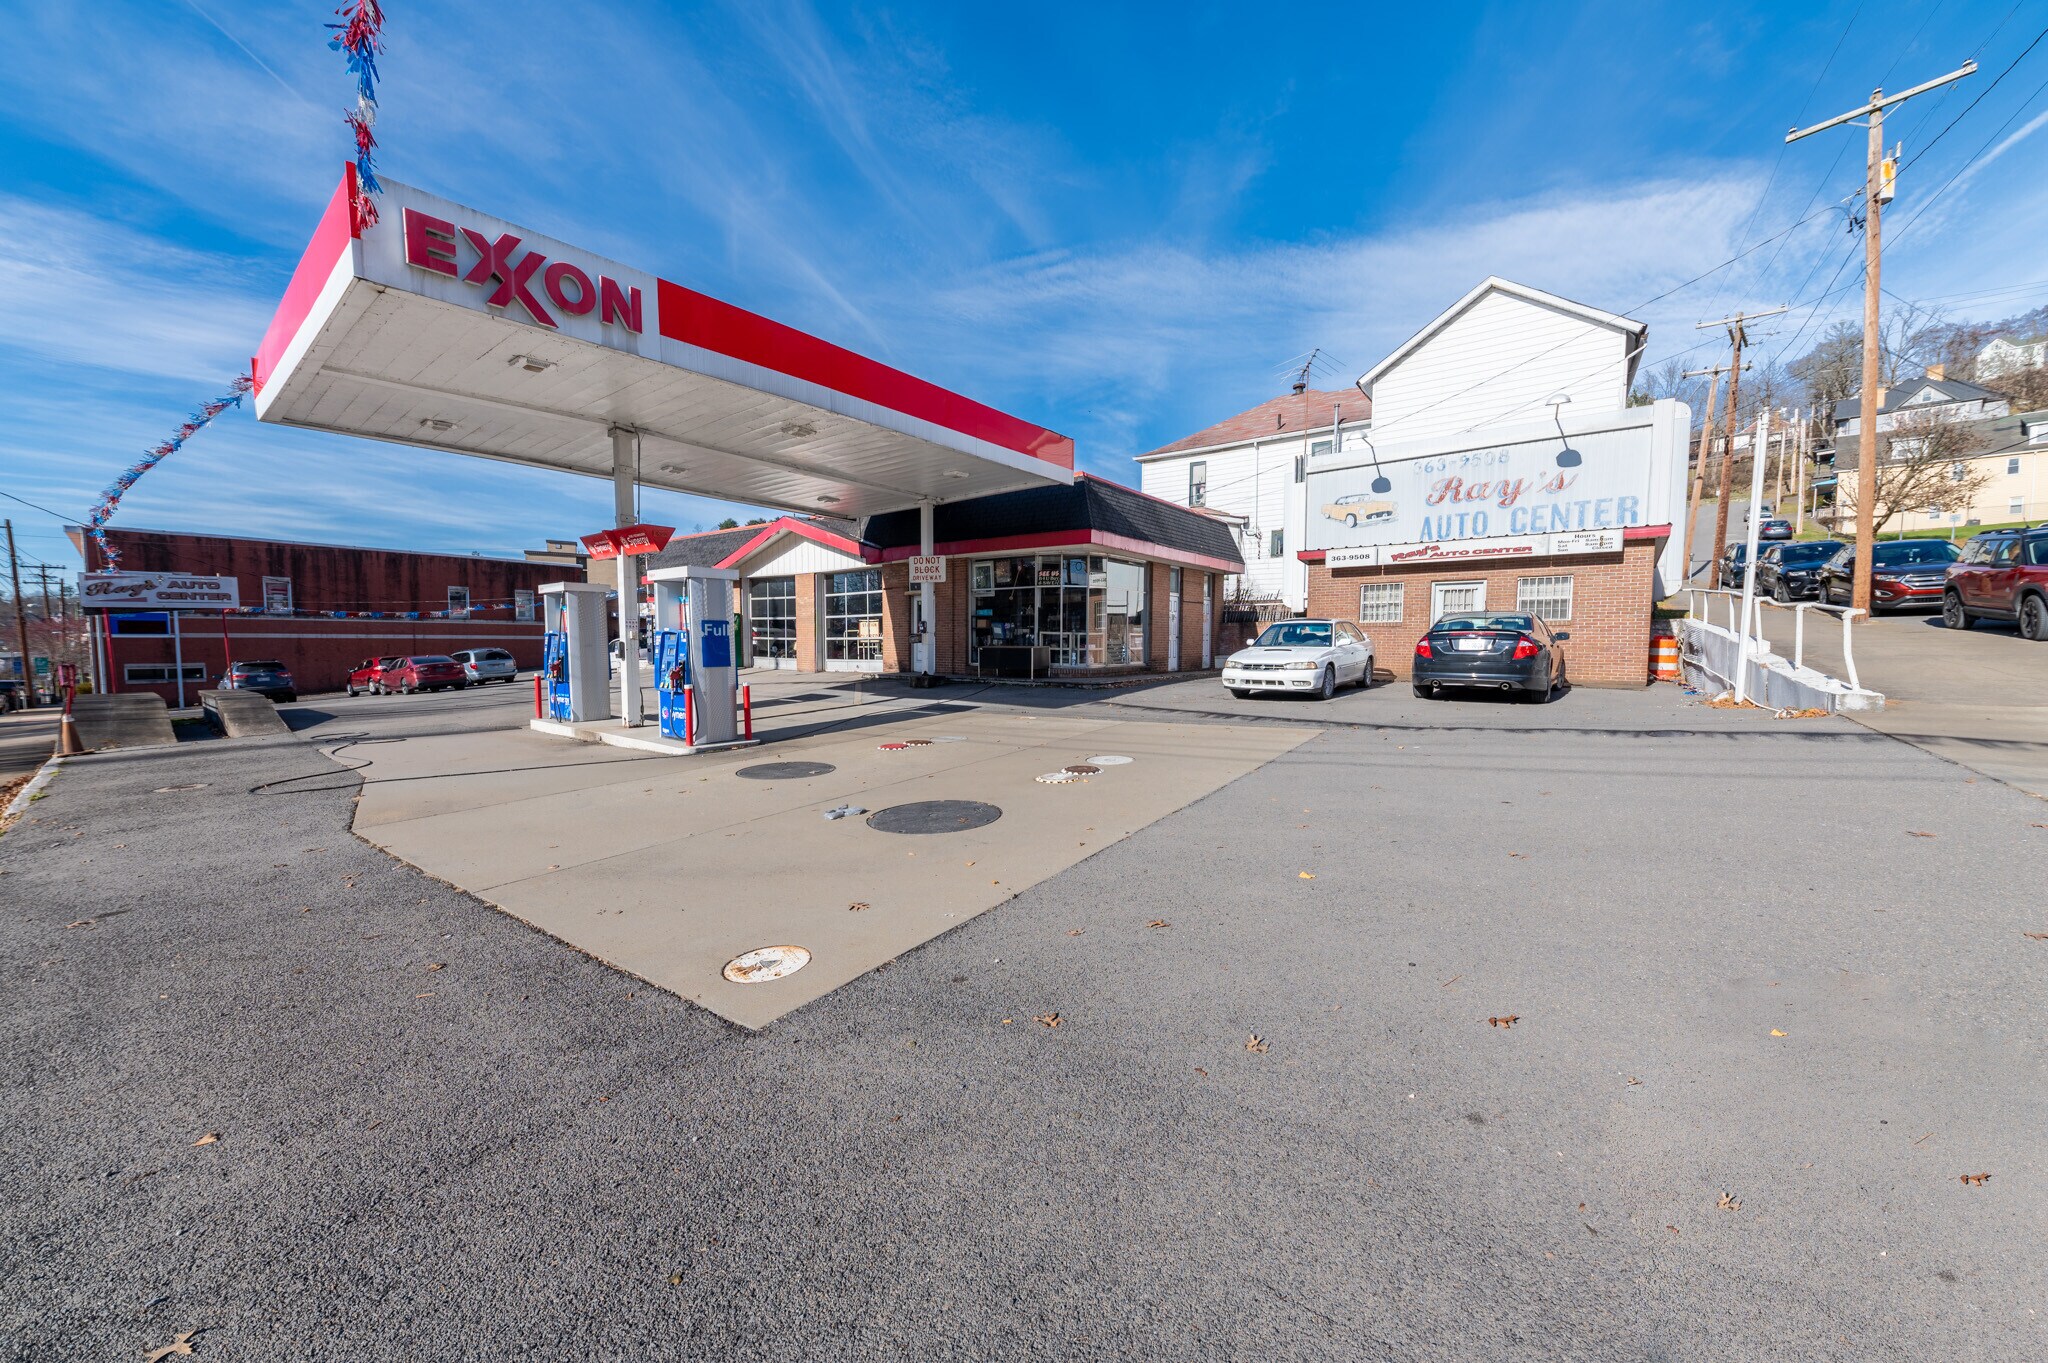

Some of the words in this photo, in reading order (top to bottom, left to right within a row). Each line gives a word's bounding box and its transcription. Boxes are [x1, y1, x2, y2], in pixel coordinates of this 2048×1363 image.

[402, 207, 642, 334] EXXON
[1413, 449, 1510, 476] 363-9508
[1425, 469, 1579, 509] Ray's
[1419, 510, 1489, 541] AUTO
[1510, 495, 1640, 534] CENTER
[1331, 553, 1370, 562] 363-9508
[1391, 545, 1440, 562] Ray's
[1430, 550, 1469, 558] AUTO
[1471, 546, 1533, 555] CENTER
[913, 556, 924, 565] DO
[925, 556, 941, 565] NOT
[914, 565, 940, 574] BLOCK
[167, 580, 221, 590] AUTO
[157, 591, 231, 600] CENTER
